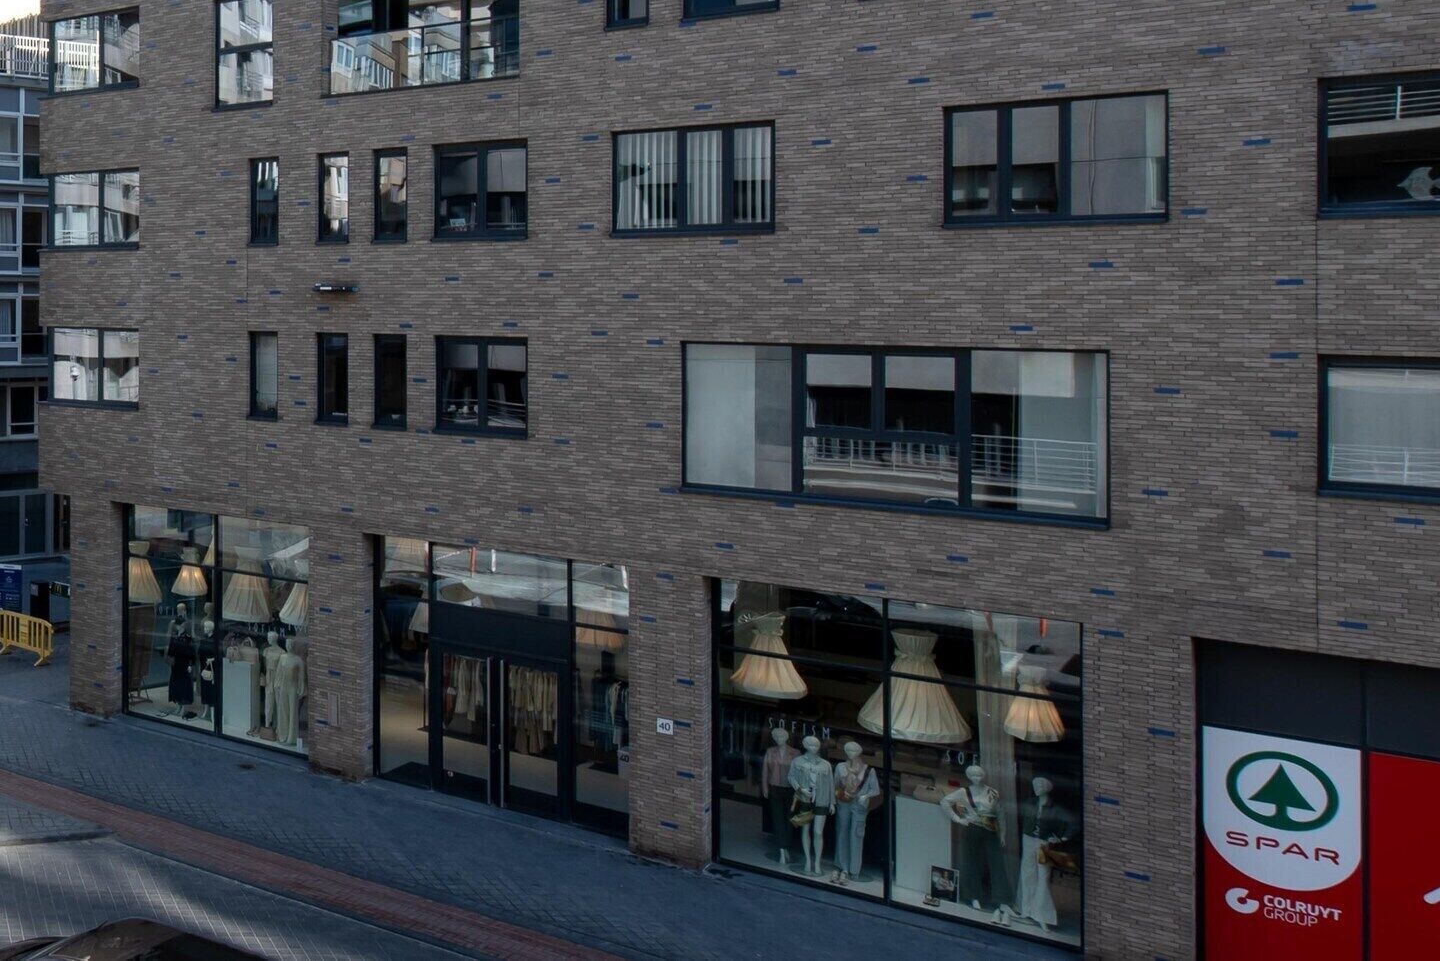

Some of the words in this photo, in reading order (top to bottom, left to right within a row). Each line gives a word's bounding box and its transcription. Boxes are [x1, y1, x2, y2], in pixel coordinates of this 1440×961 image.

[658, 722, 671, 731] 40
[768, 717, 830, 740] SOFISM
[1226, 831, 1339, 865] SPAR
[1263, 894, 1342, 920] COLRUYT
[1263, 907, 1318, 927] GROUP
